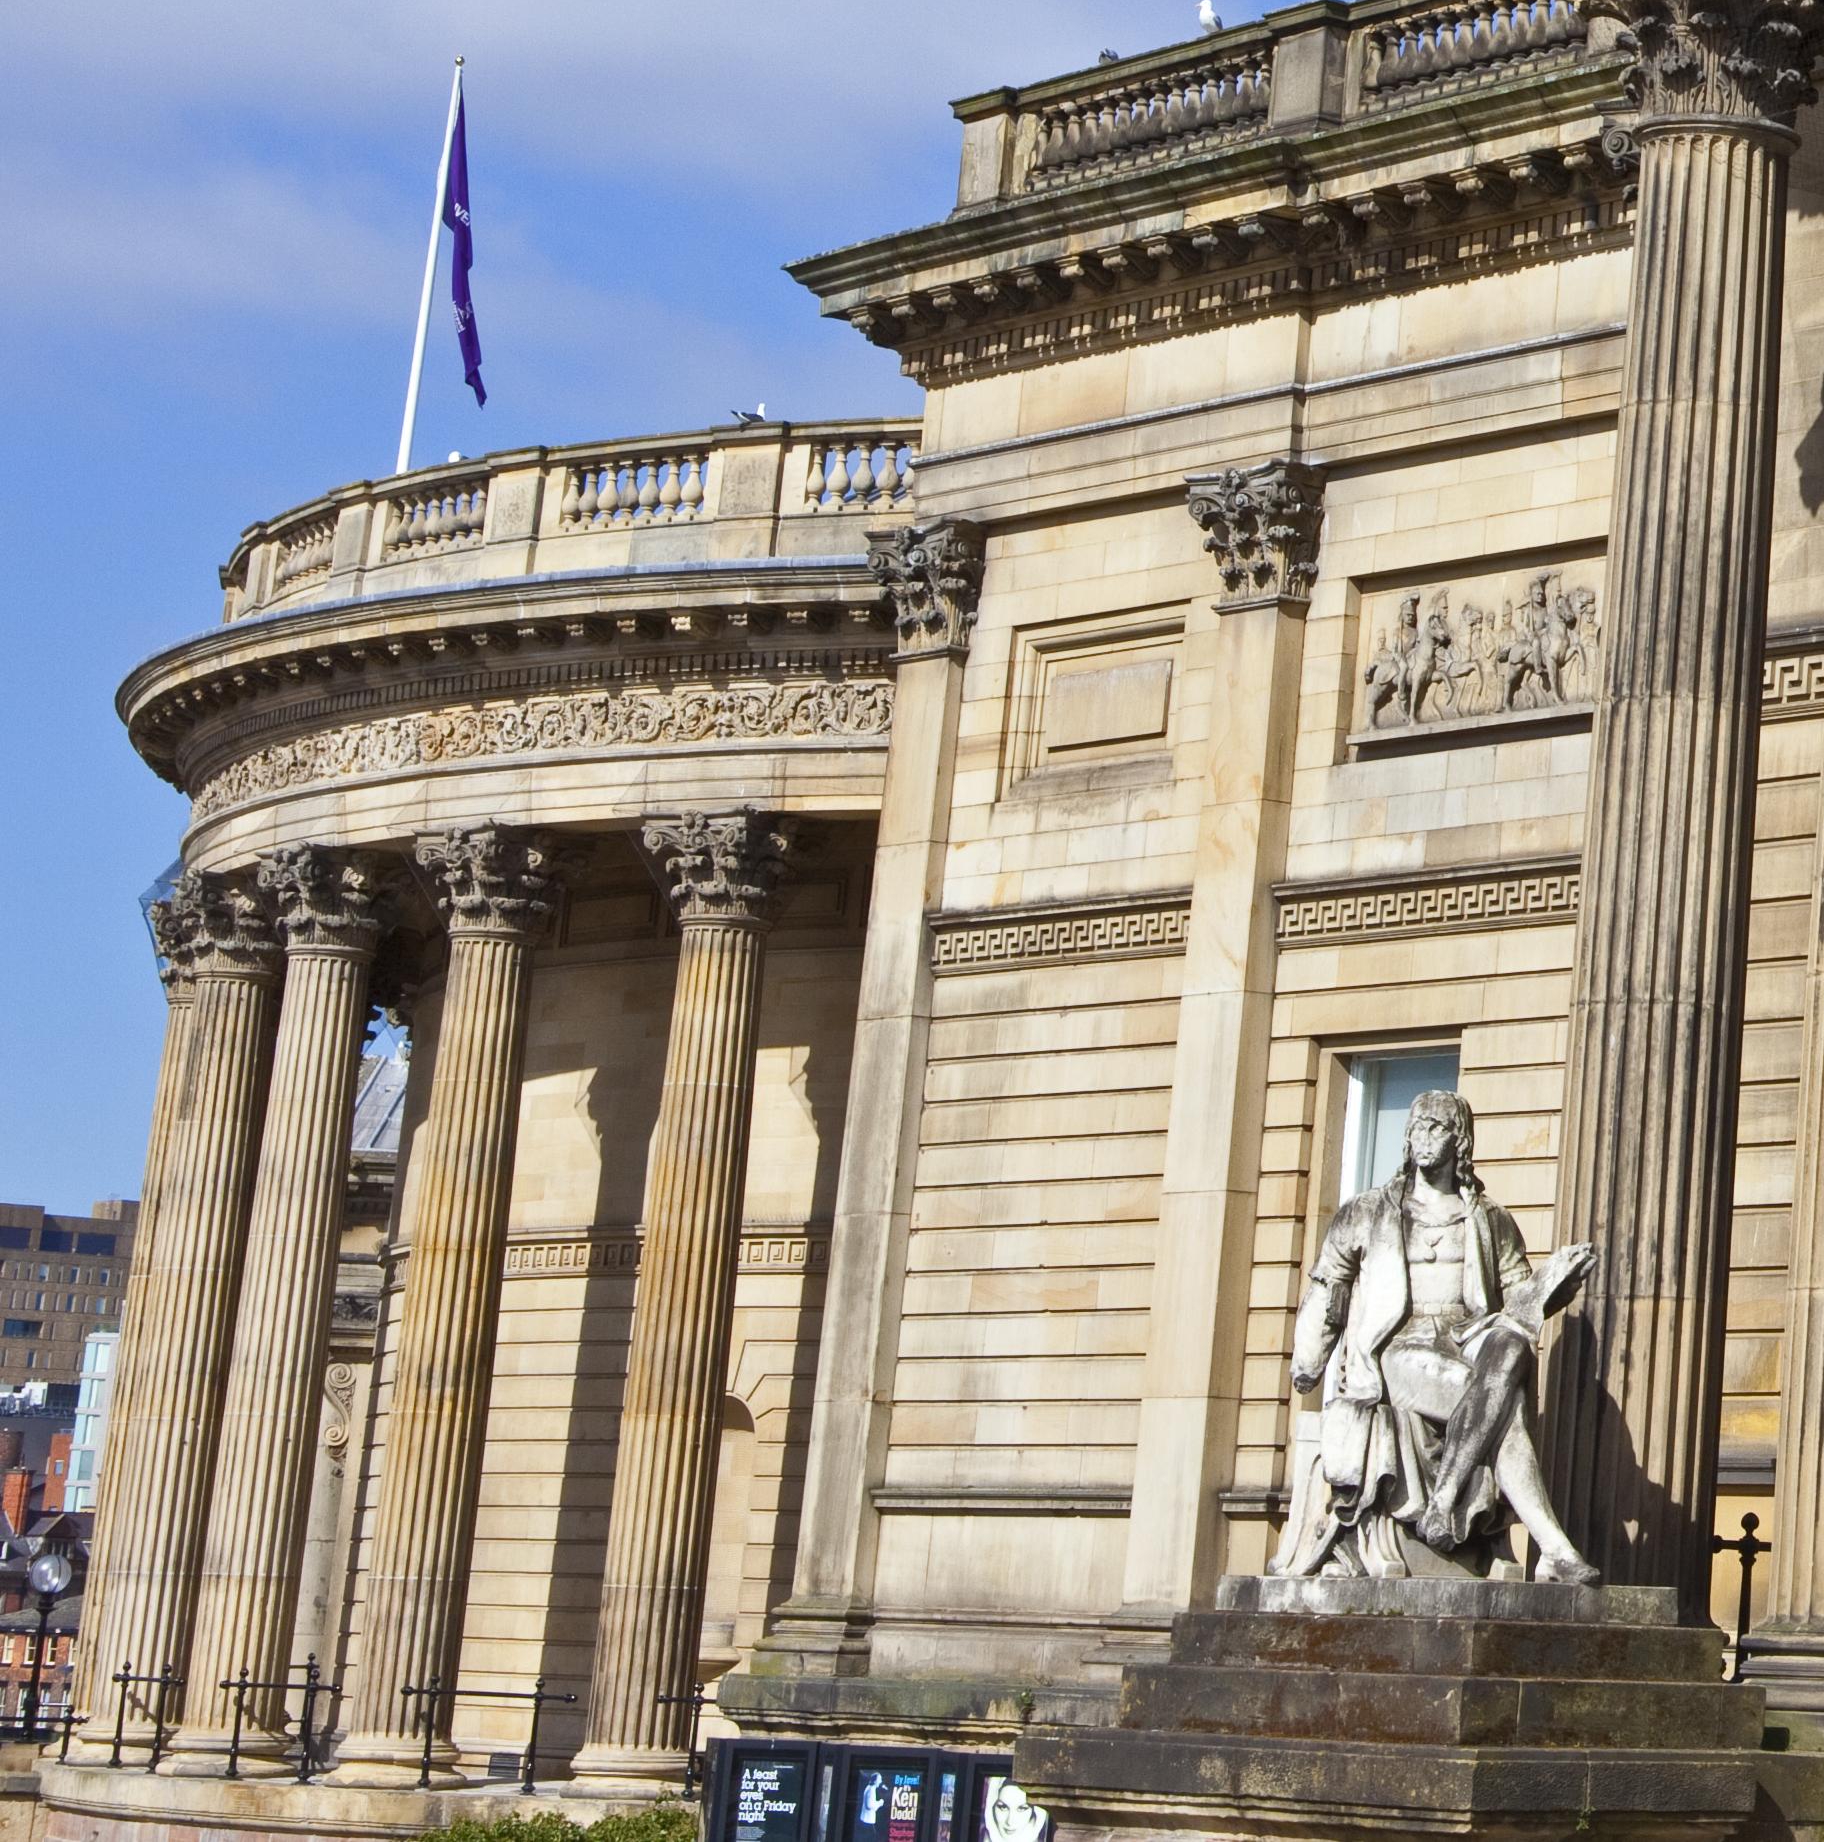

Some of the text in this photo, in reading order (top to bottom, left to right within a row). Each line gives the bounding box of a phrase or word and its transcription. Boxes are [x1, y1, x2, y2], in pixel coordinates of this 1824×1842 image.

[742, 1769, 778, 1779] A feast
[741, 1779, 780, 1792] for your
[740, 1790, 764, 1801] eyes
[891, 1786, 918, 1807] Ken
[738, 1800, 796, 1814] on a Friday
[890, 1807, 917, 1820] Dodd!
[738, 1811, 766, 1823] night.
